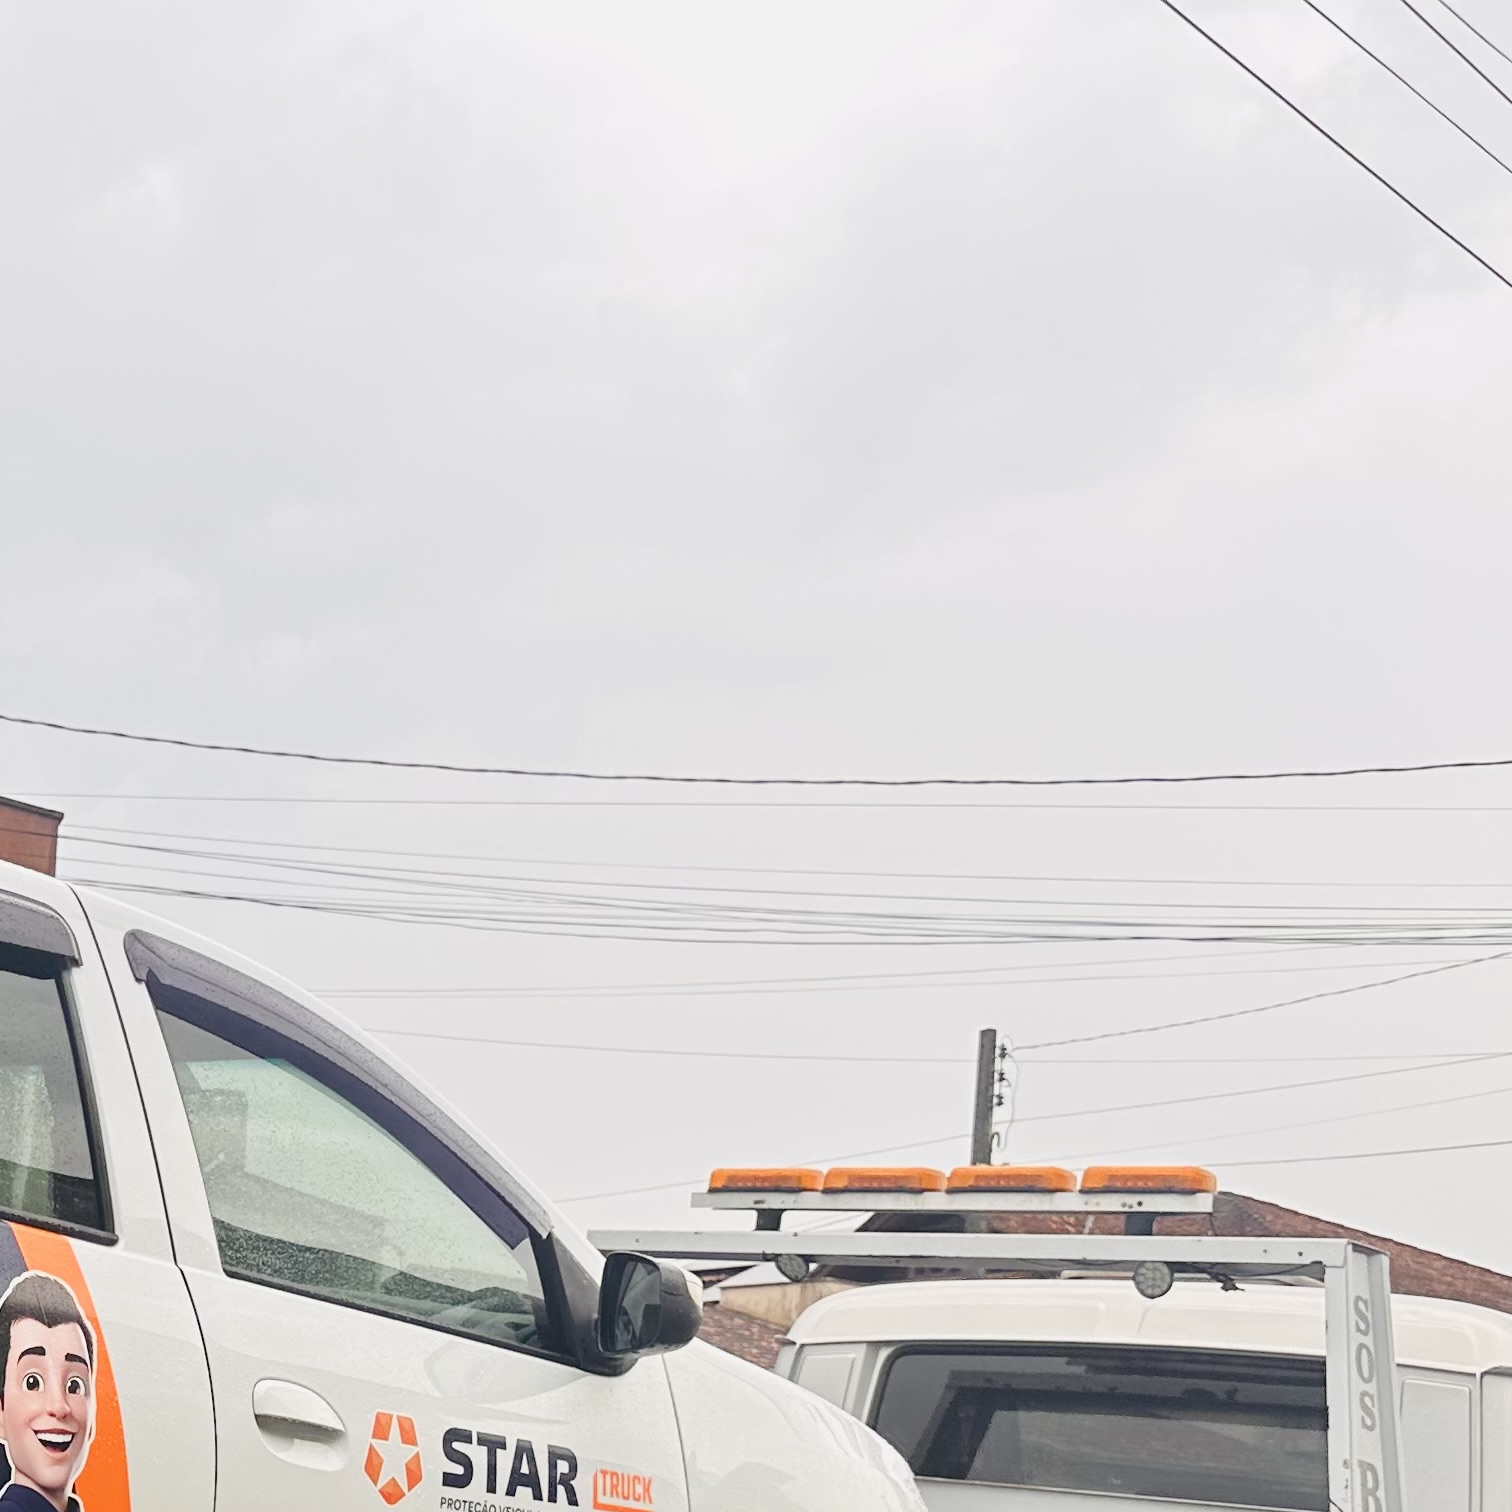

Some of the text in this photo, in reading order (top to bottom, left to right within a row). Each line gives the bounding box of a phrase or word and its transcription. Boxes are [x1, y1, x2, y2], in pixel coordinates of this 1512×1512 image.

[1352, 1294, 1377, 1433] SOS
[441, 1426, 580, 1508] STAR
[599, 1468, 655, 1505] TRUCK
